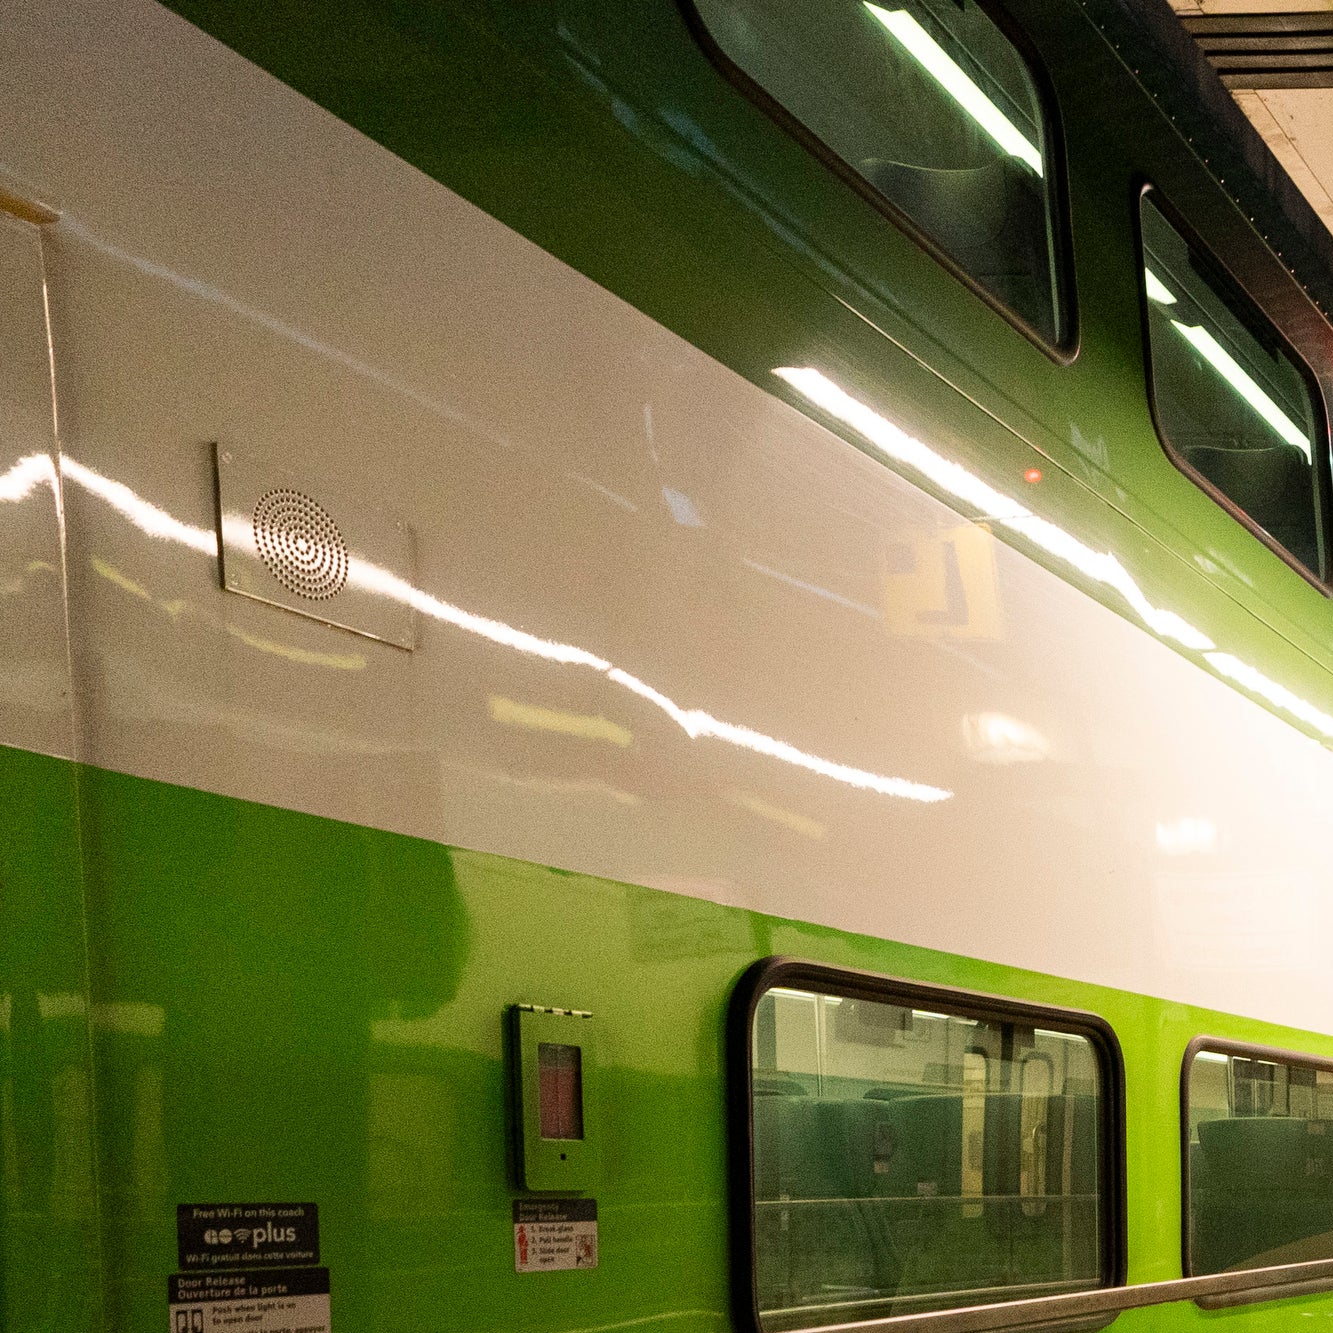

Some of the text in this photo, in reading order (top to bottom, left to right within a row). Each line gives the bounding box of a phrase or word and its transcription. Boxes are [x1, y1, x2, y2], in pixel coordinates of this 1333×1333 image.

[192, 1206, 305, 1219] Free Wi-Fi on this coach
[252, 1221, 297, 1249] plus
[177, 1276, 246, 1289] Door Release
[177, 1284, 288, 1300] Ouverture de la porte
[212, 1305, 232, 1315] Push
[234, 1304, 256, 1313] when
[257, 1302, 276, 1313] light
[212, 1314, 263, 1326] to open door
